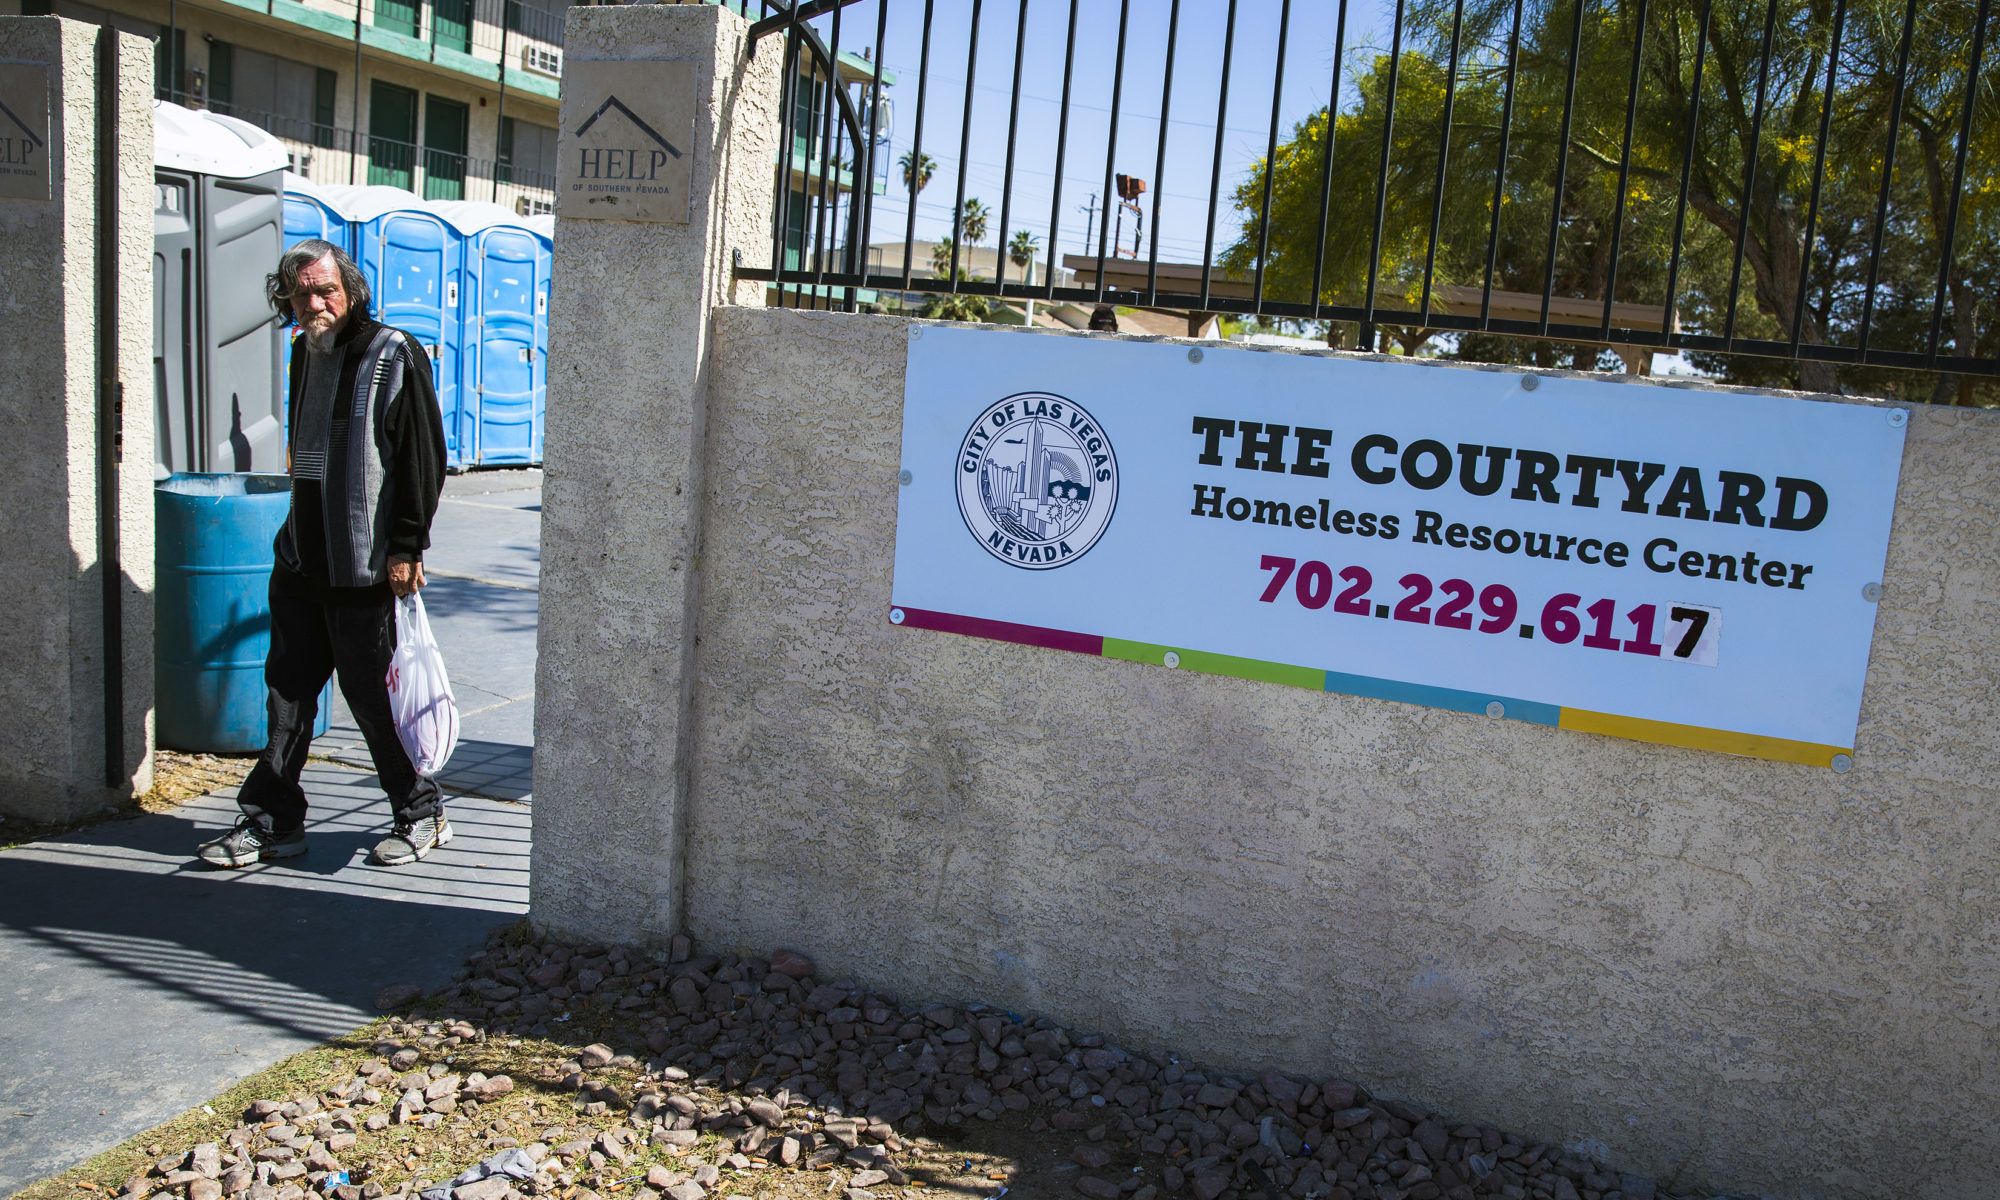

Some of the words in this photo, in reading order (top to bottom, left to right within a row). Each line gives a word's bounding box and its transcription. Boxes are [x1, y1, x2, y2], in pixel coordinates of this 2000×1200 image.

[572, 183, 584, 191] OF
[587, 184, 632, 193] SOUTHERN
[636, 184, 670, 194] NEVADA
[577, 148, 668, 180] HELP
[963, 424, 991, 474] CITY
[991, 403, 1017, 428] OF
[1023, 400, 1063, 420] LAS
[1069, 411, 1111, 483] VEGAS
[1192, 416, 1333, 478] THE
[1350, 433, 1829, 532] COURTYARD
[987, 530, 1074, 563] NEVADA
[1190, 483, 1400, 540] Homeless
[1412, 509, 1629, 568] Resource
[1643, 537, 1814, 591] Center
[1258, 554, 1710, 659] 702.229.6117
